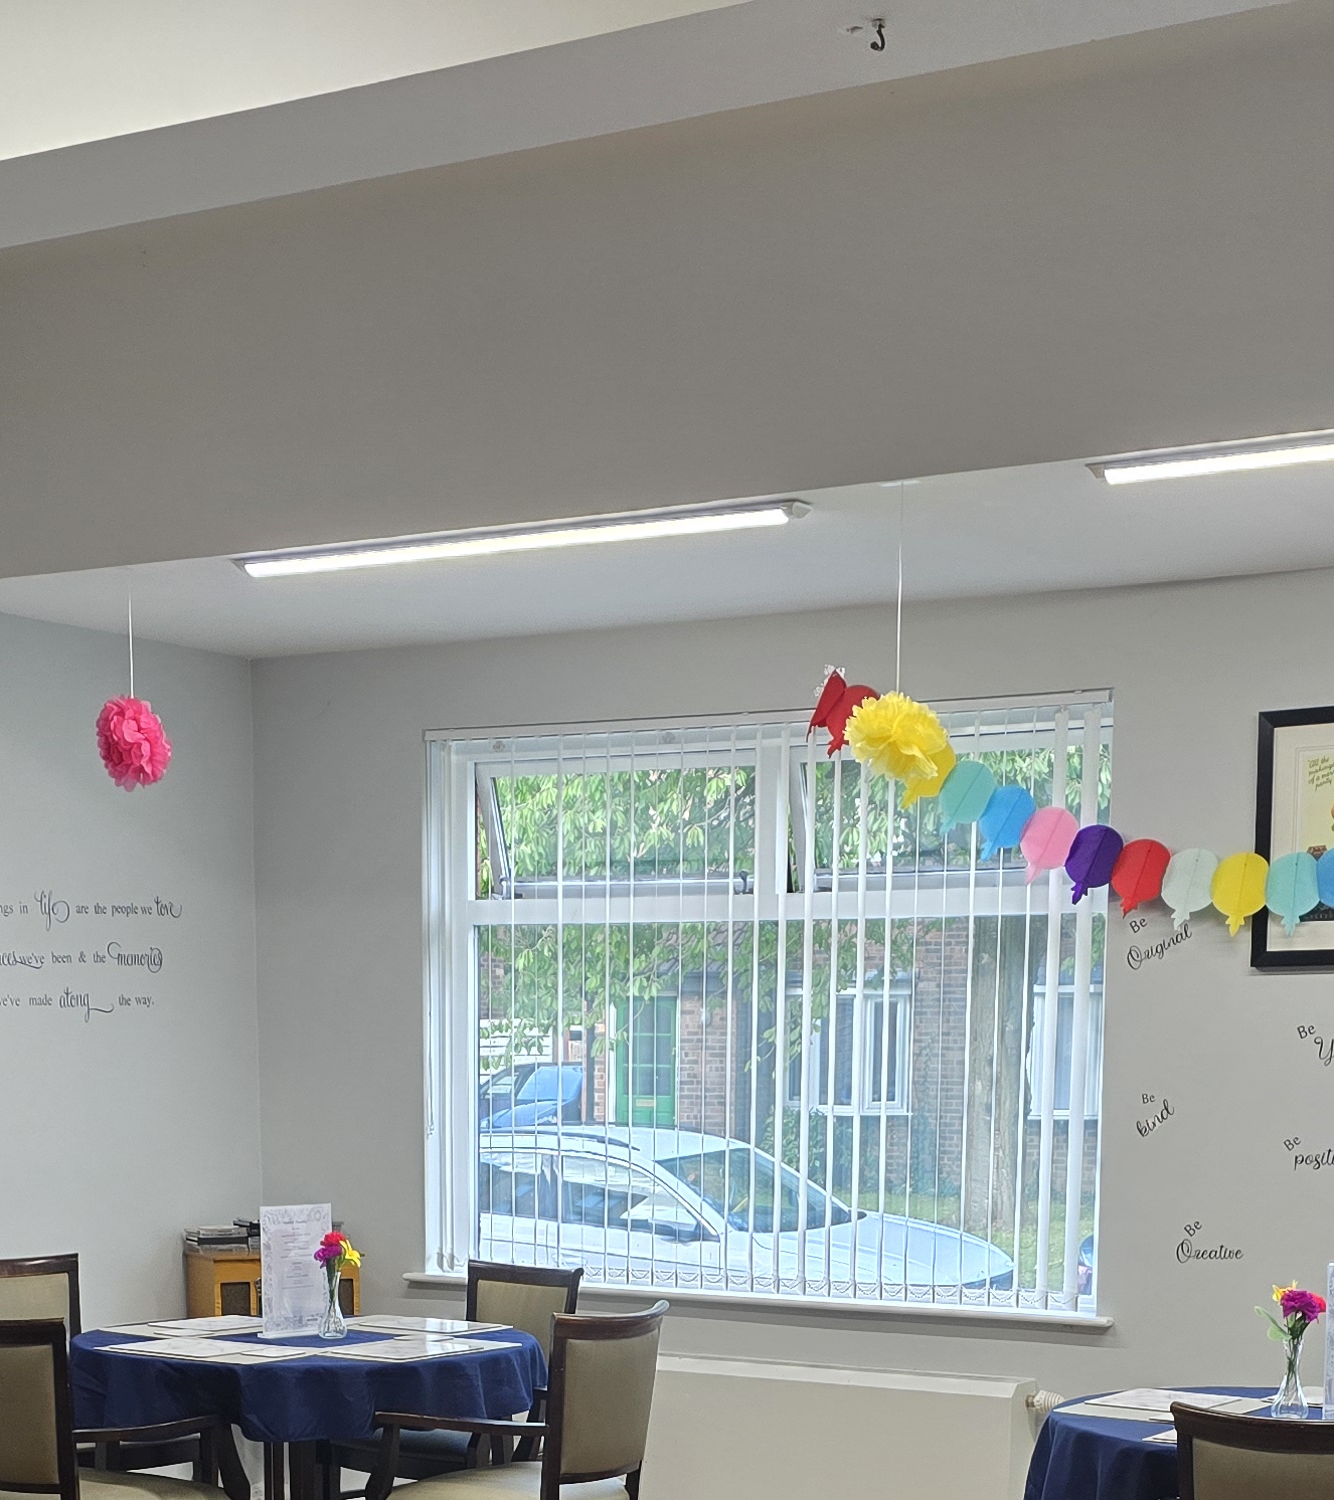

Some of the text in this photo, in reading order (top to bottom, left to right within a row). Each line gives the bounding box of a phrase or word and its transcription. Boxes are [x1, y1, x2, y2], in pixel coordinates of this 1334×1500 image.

[19, 902, 28, 914] in
[76, 904, 89, 914] are
[94, 901, 107, 914] the
[111, 901, 139, 917] people
[141, 905, 152, 915] we
[1129, 915, 1148, 934] Be
[1126, 923, 1193, 971] Original
[51, 952, 72, 964] been
[78, 952, 87, 963] &
[93, 952, 106, 964] the
[29, 994, 53, 1007] made
[118, 995, 131, 1007] the
[1297, 1022, 1316, 1041] Be
[1141, 1092, 1156, 1105] Be
[1136, 1099, 1175, 1138] kind
[1283, 1134, 1302, 1152] Be
[1184, 1219, 1203, 1237] Be
[1175, 1239, 1244, 1263] Creative
